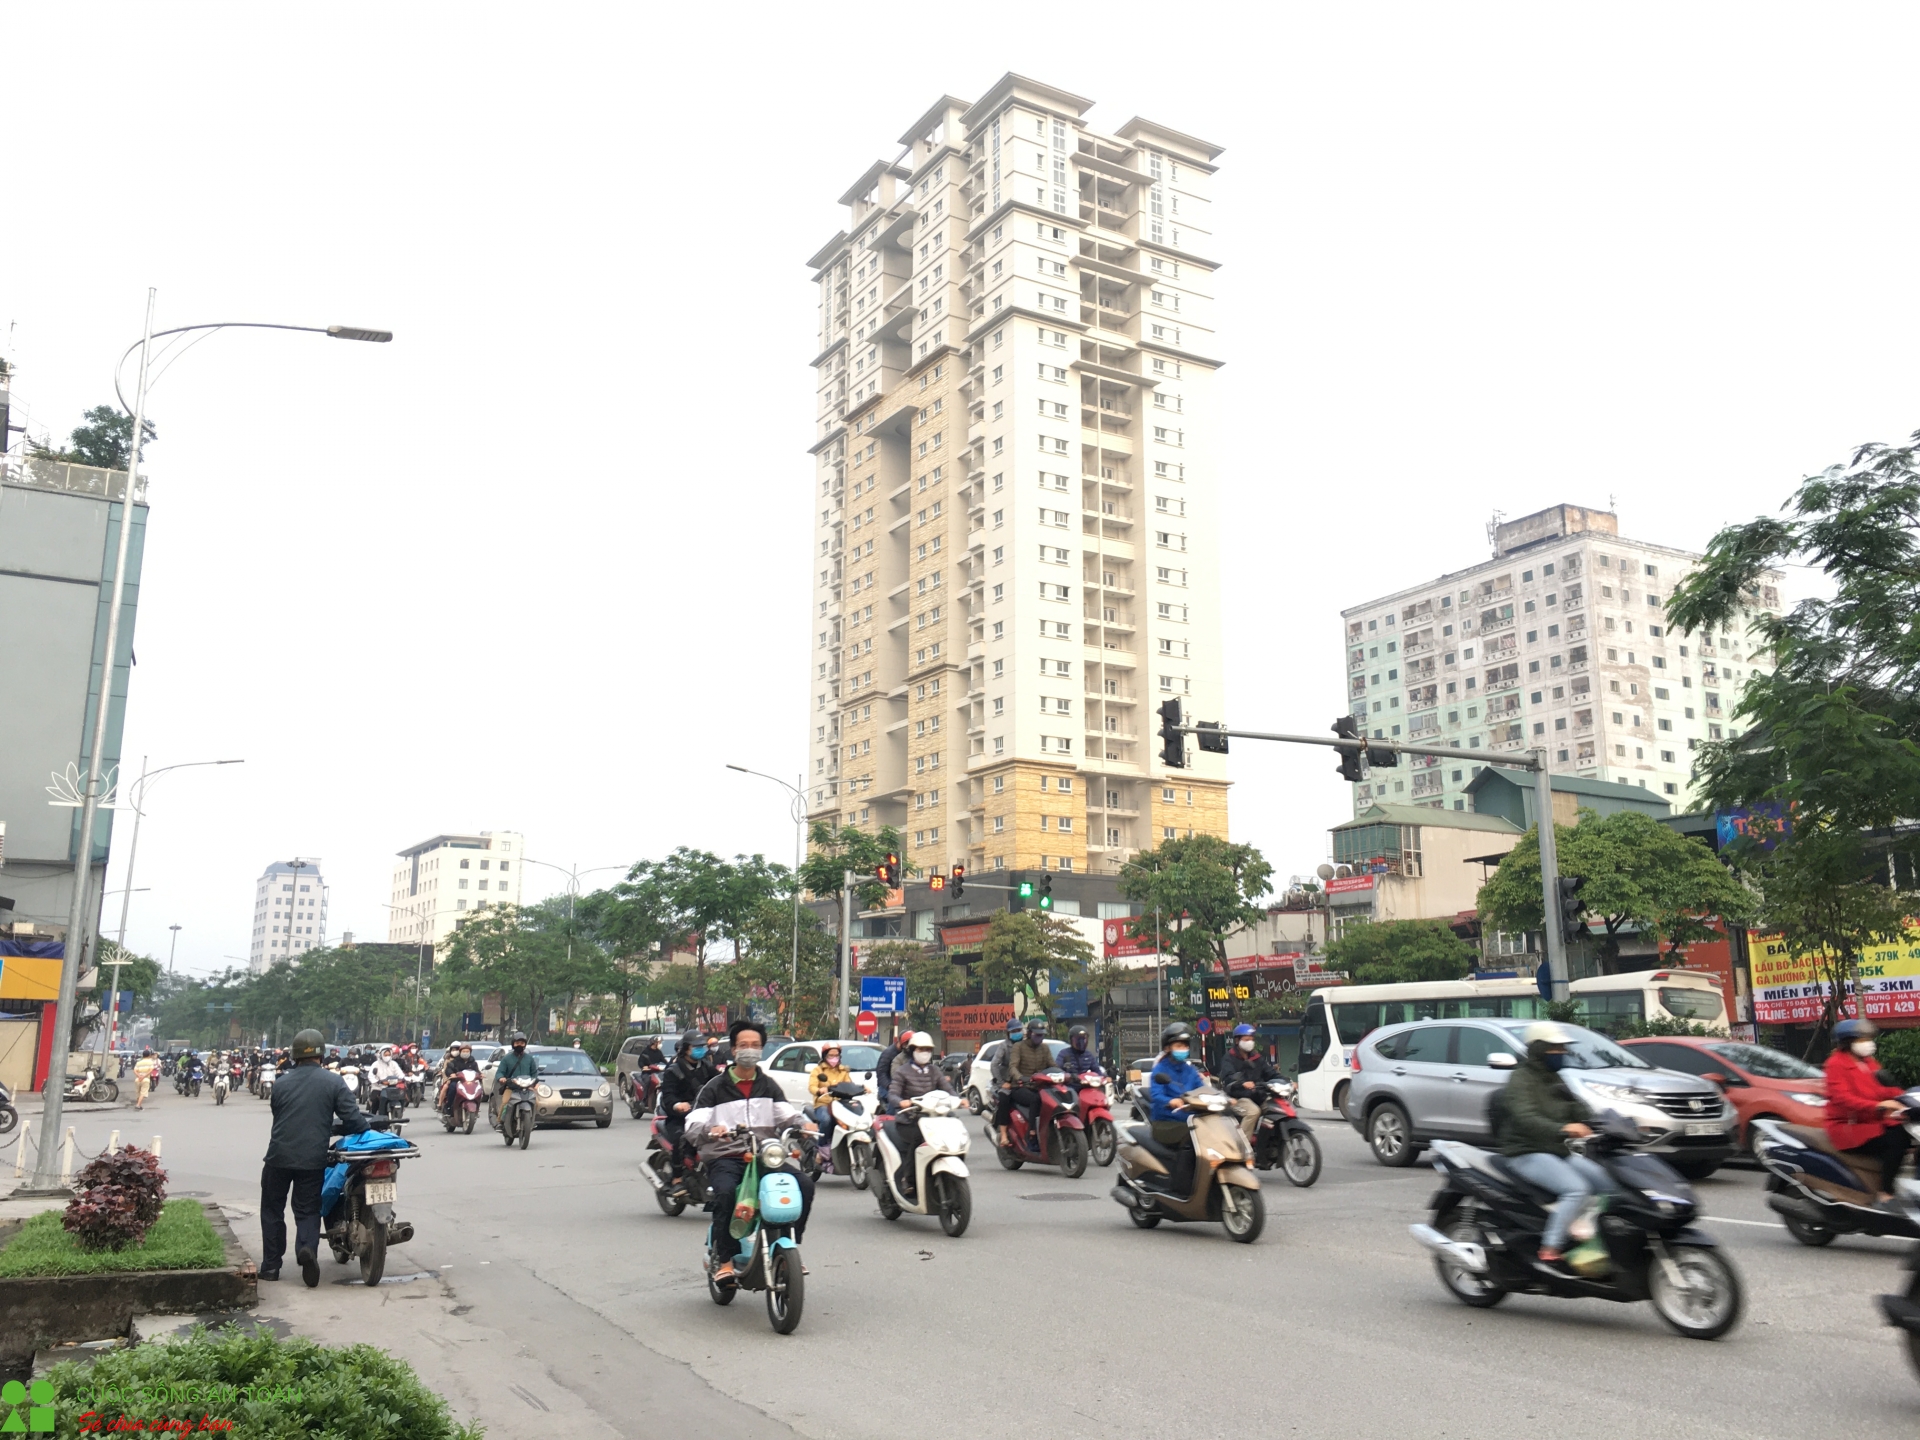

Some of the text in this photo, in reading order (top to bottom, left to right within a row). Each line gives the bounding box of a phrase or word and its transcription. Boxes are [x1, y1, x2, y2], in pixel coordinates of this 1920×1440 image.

[1875, 950, 1899, 962] 379K
[1756, 974, 1770, 985] GÀ
[1880, 980, 1914, 992] 3KM
[1866, 1002, 1891, 1014] 0971
[1894, 1000, 1915, 1013] 429
